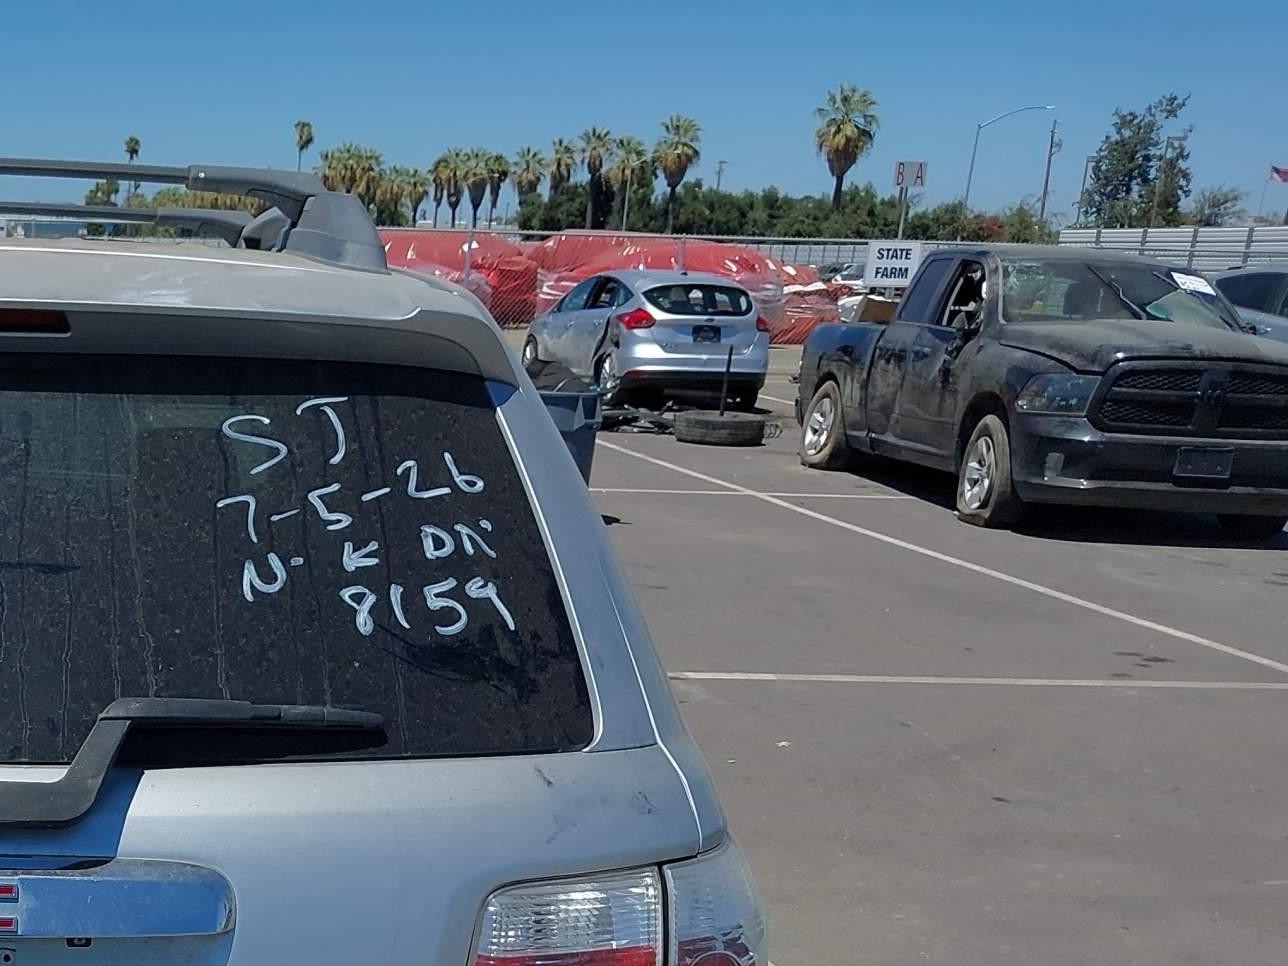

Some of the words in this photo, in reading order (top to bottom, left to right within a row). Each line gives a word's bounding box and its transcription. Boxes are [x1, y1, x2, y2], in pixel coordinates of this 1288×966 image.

[896, 162, 905, 186] B
[913, 162, 924, 186] A
[876, 247, 913, 261] STATE
[874, 266, 909, 279] FARM
[216, 451, 485, 543] 7-5-26
[339, 576, 515, 636] 8159
